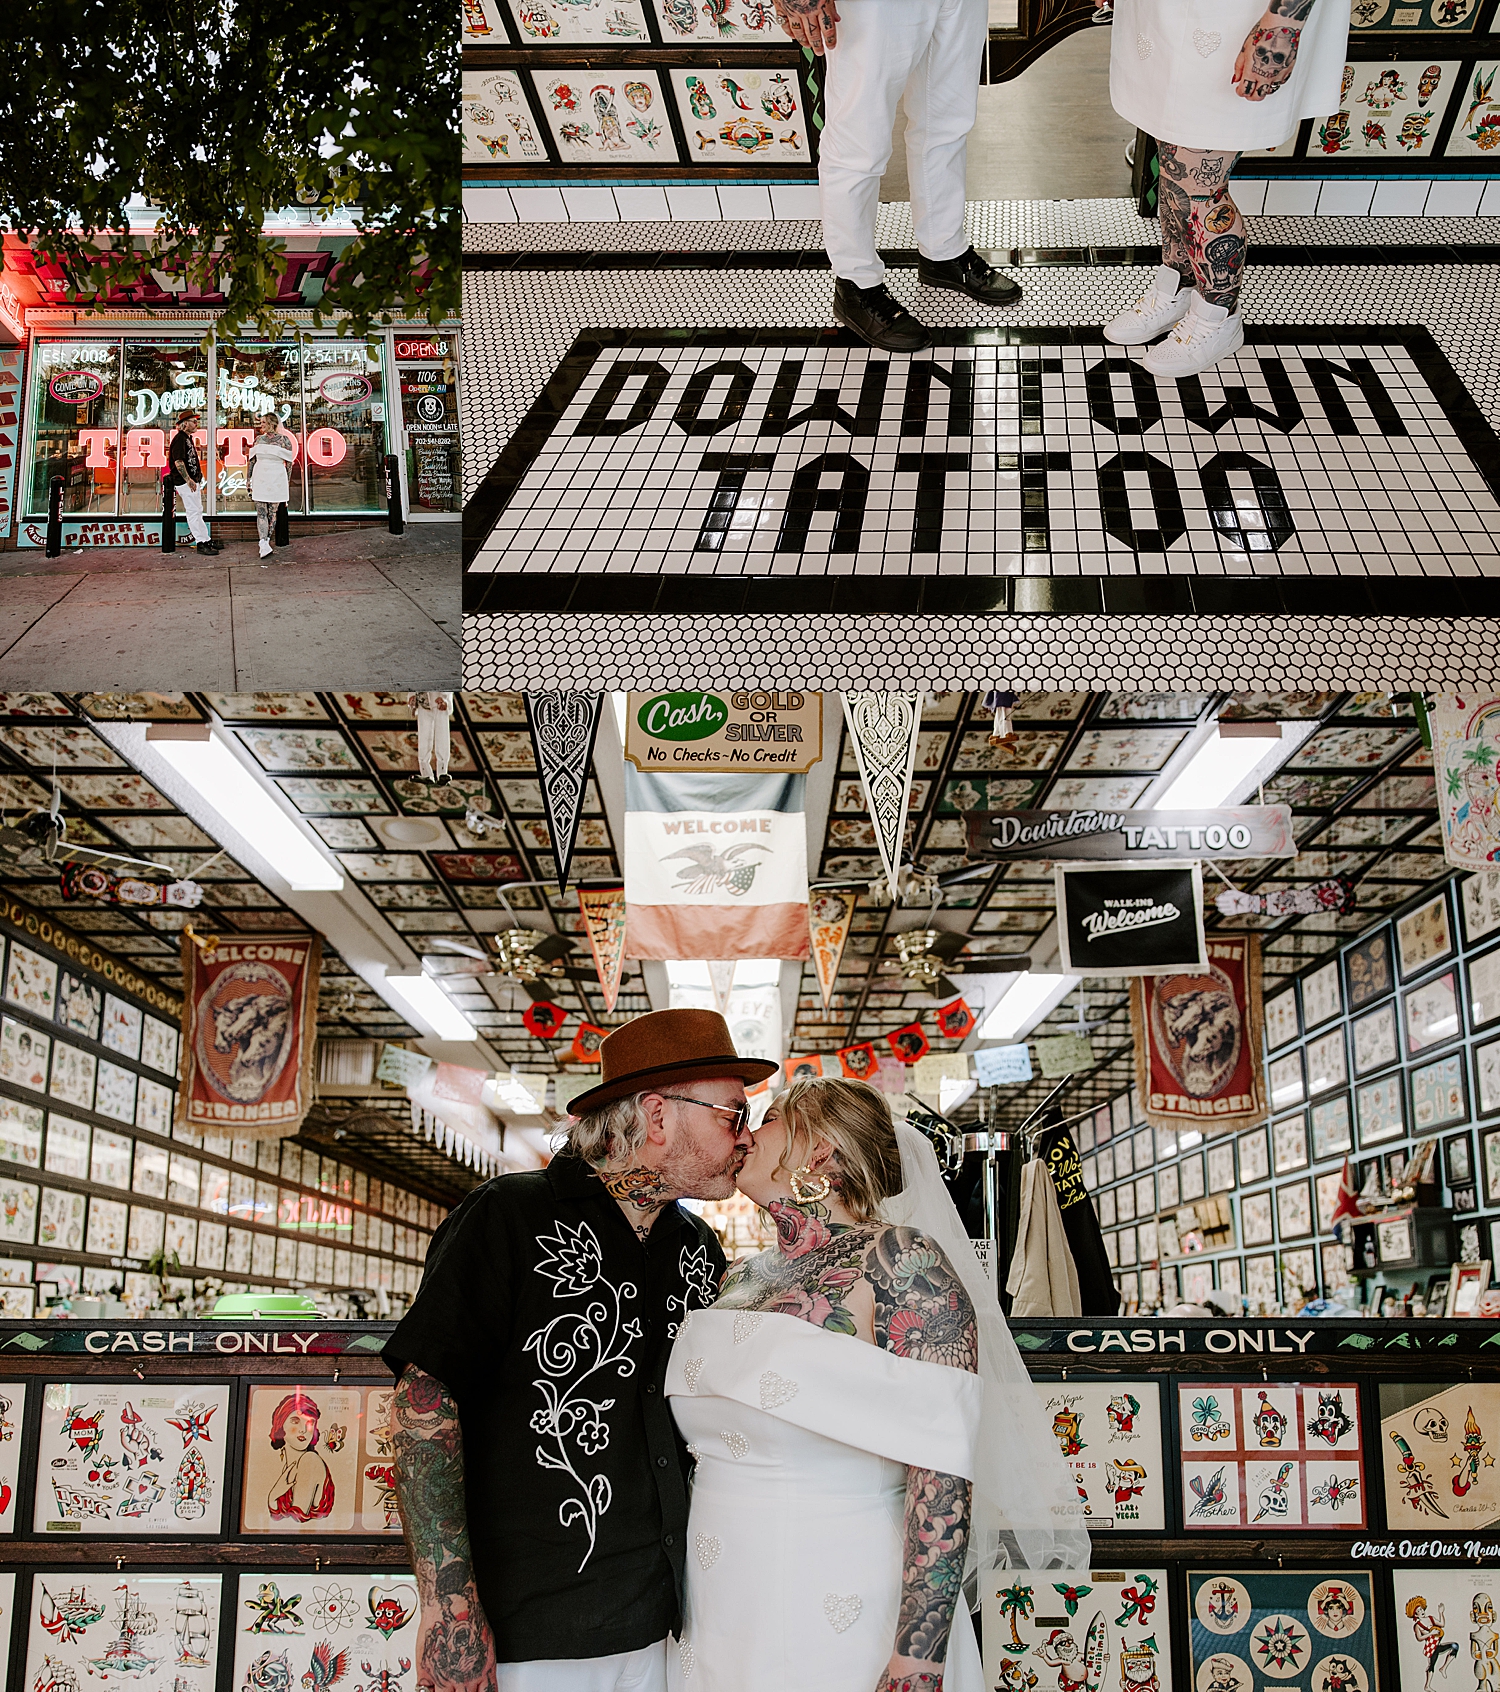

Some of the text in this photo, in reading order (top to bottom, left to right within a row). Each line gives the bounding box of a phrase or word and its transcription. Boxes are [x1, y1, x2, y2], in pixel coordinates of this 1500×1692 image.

[71, 348, 109, 362] 2008
[398, 342, 438, 357] OPEN
[417, 371, 437, 383] 1106
[407, 384, 447, 394] Open to All
[573, 356, 1410, 439] DOWNTOWN
[406, 424, 422, 432] OPEN
[444, 423, 458, 431] LATE
[217, 470, 248, 496] Vega
[695, 451, 1297, 554] TATTOO
[80, 523, 145, 533] MORE
[65, 532, 161, 546] PARKING
[731, 691, 805, 711] GOLD
[647, 693, 725, 733] Cash,
[749, 712, 778, 723] OR
[724, 723, 804, 743] SILVER
[647, 748, 668, 761] No
[753, 748, 798, 762] Credit
[662, 817, 772, 836] WELCOME
[990, 809, 1252, 851] Downtown TATTOO
[1103, 898, 1154, 909] WALK-INS
[1081, 902, 1182, 941] Welcome
[200, 945, 307, 967] WELCOME
[742, 1001, 773, 1019] EYE
[192, 1099, 298, 1121] STRANGER
[1150, 1092, 1253, 1114] STRANGER
[1061, 1188, 1087, 1210] Las
[84, 1331, 320, 1354] CASH ONLY
[1065, 1329, 1316, 1354] CASH ONLY
[1044, 1394, 1085, 1411] Las Vegas
[73, 1429, 94, 1438] MOM
[141, 1422, 159, 1444] LUCK
[1192, 1423, 1228, 1434] GOOD LUCK
[102, 1481, 120, 1491] YOURS
[1195, 1506, 1237, 1518] Mother
[1350, 1541, 1396, 1559] Check
[1398, 1540, 1430, 1558] Out
[1429, 1540, 1462, 1558] Our
[1086, 1622, 1106, 1678] Mele Kalikimaka
